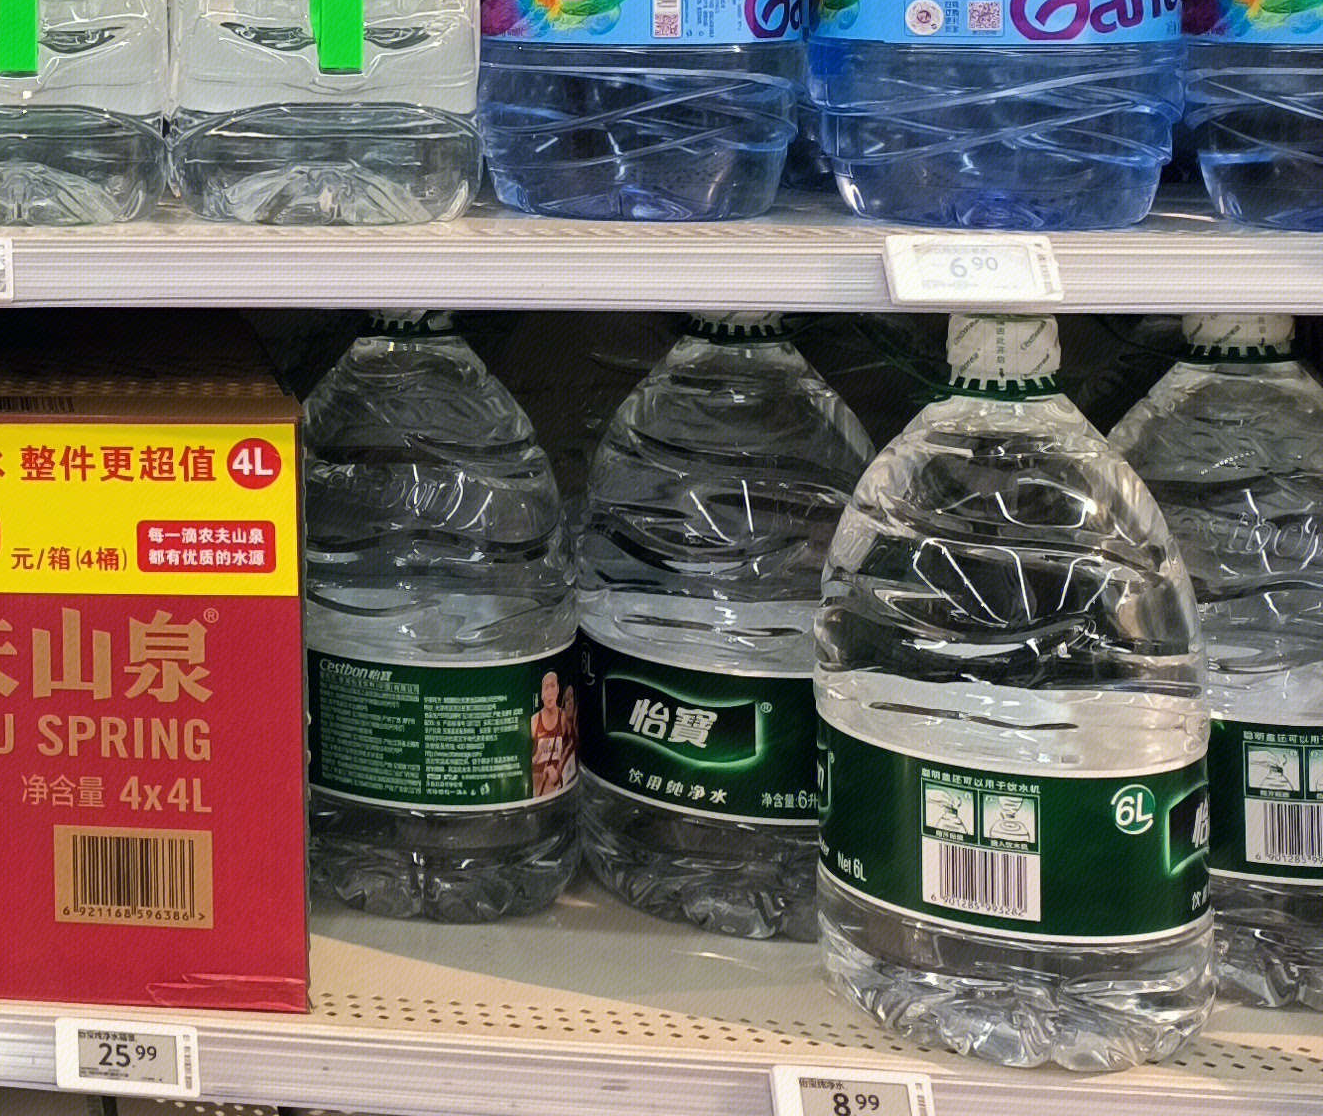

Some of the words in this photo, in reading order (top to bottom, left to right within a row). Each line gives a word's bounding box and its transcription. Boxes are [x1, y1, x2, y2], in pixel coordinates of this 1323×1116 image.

[20, 445, 217, 483] 整件更超值
[231, 447, 274, 476] 4L
[147, 526, 265, 545] 每一滴农夫山泉
[148, 549, 265, 567] 都有优质的水源
[36, 714, 212, 761] SPRING
[628, 698, 719, 749] 怡寶
[628, 766, 728, 807] 饮用纯净水
[1114, 796, 1153, 829] 6L
